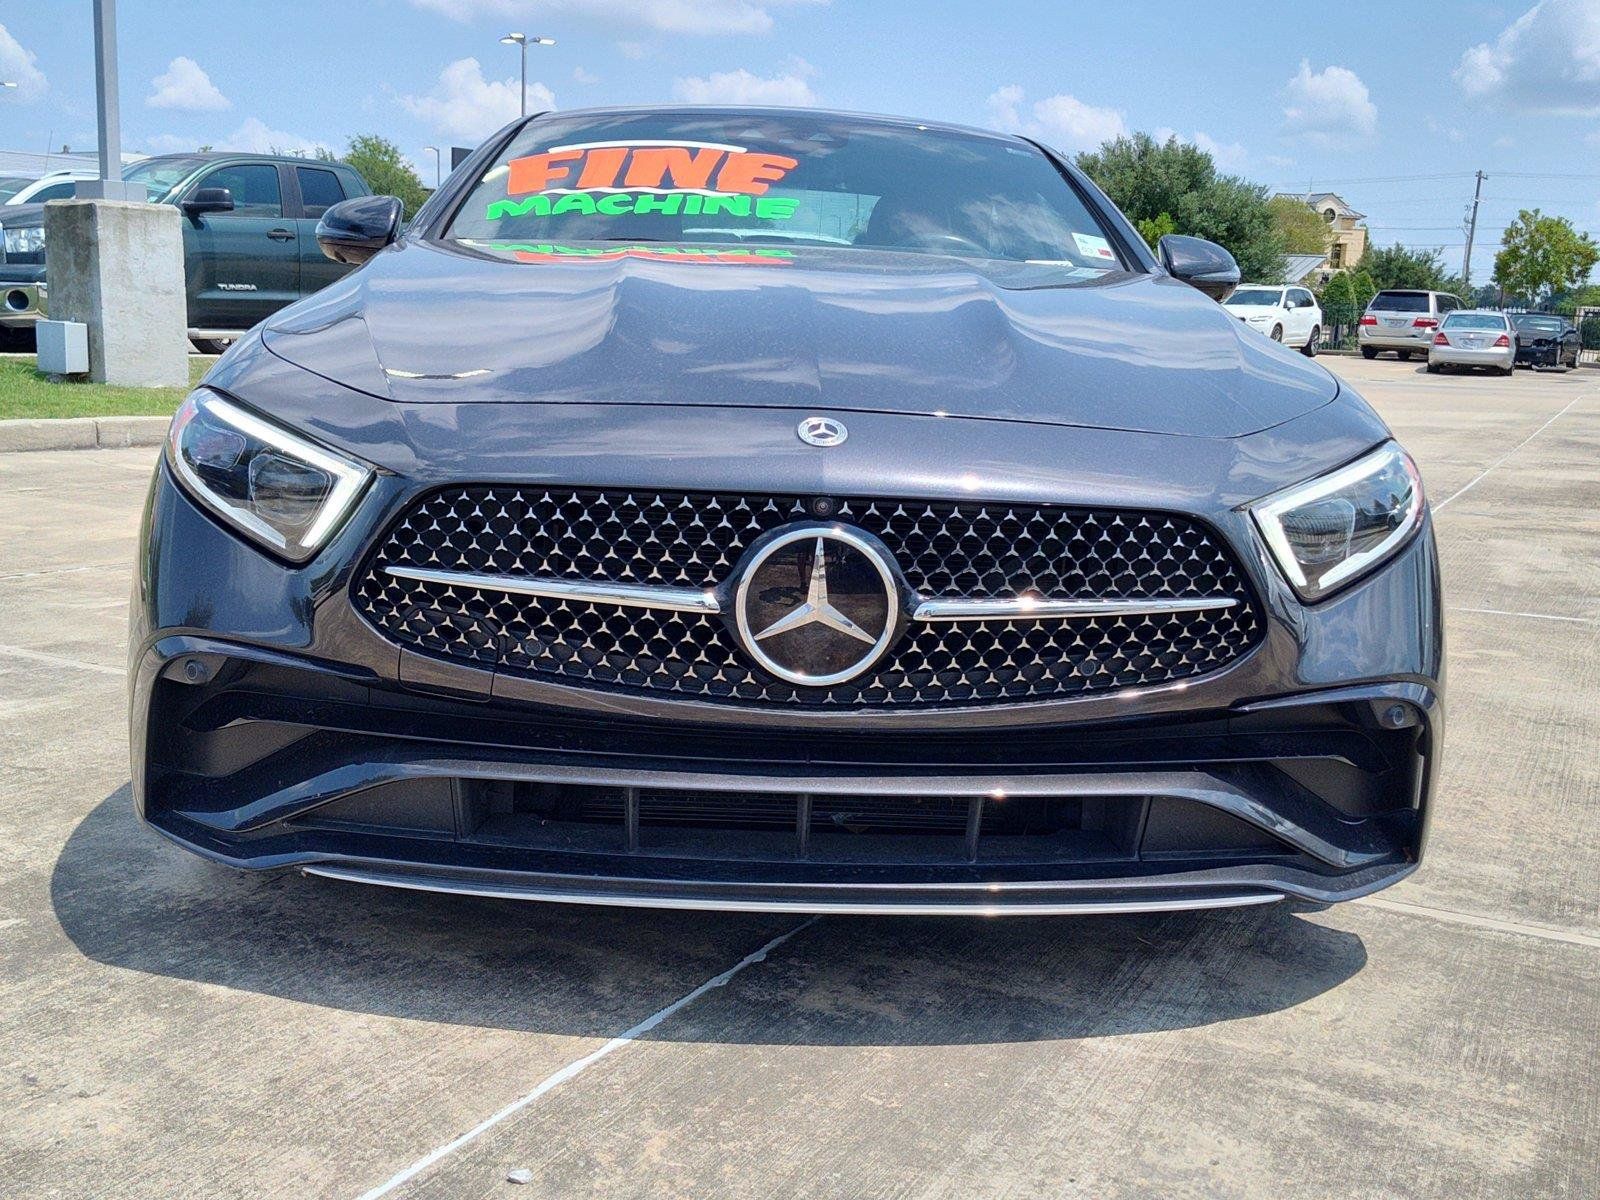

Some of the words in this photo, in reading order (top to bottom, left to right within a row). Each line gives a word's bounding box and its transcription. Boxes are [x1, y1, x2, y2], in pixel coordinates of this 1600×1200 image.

[507, 148, 798, 194] FINE
[486, 194, 800, 220] MACHINE
[217, 283, 258, 291] TUNDRA
